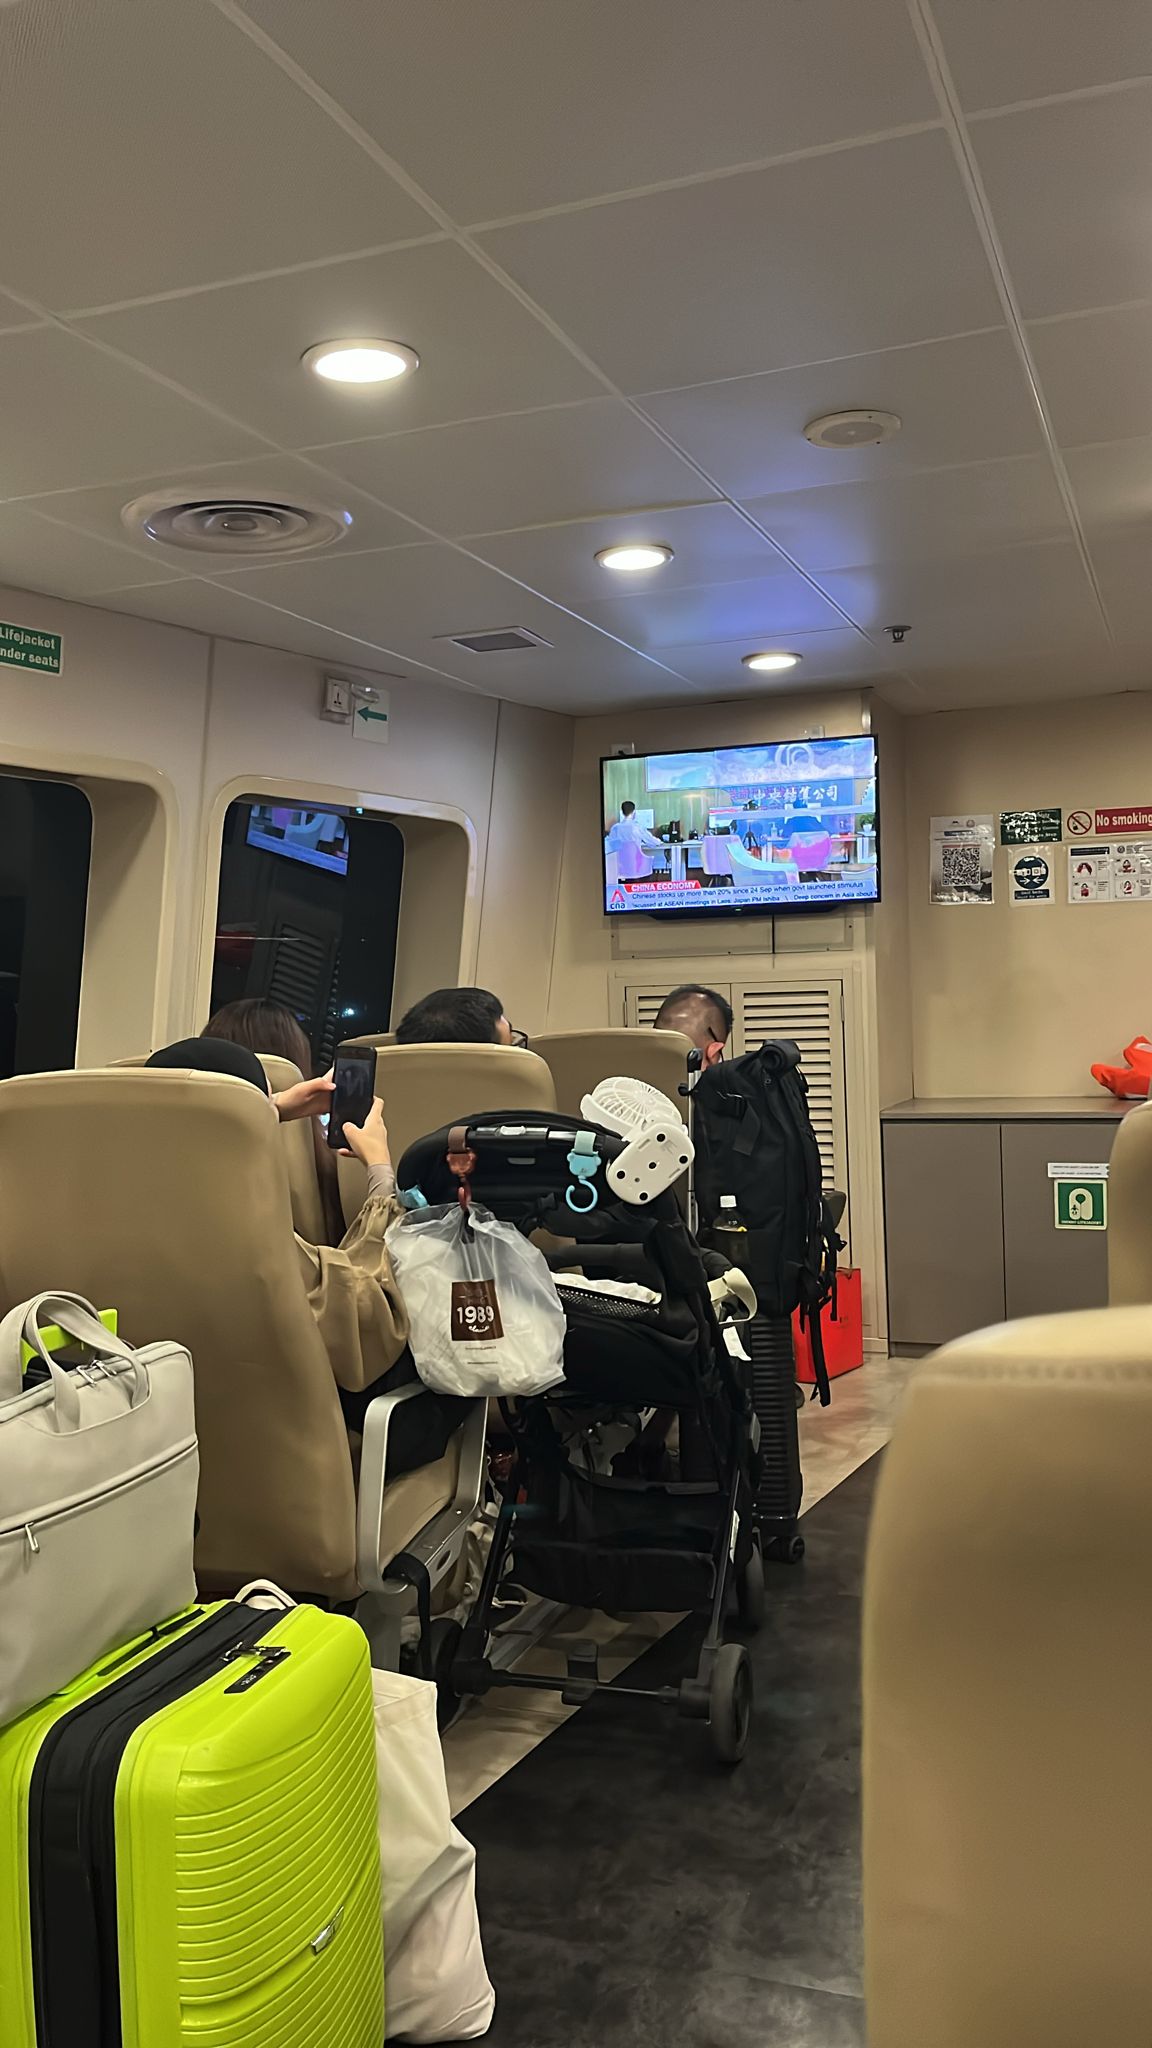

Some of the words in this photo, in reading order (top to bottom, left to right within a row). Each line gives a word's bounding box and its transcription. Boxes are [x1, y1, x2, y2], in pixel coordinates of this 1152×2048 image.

[0, 626, 55, 650] Lifejacket
[0, 647, 26, 661] nder
[29, 654, 59, 668] seats
[1096, 814, 1110, 826] No
[1112, 811, 1152, 826] smoking
[631, 883, 655, 892] CHINA
[657, 881, 696, 891] ECONOMY
[632, 892, 656, 900] Chinese
[658, 891, 676, 899] stocks
[677, 891, 685, 899] up
[703, 888, 716, 896] than
[717, 888, 731, 896] 20%
[760, 886, 772, 894] Sep
[791, 885, 805, 893] govt
[806, 883, 836, 891] launched
[837, 881, 864, 889] stimulus
[632, 901, 657, 909] scussed
[685, 898, 709, 906] meetings
[456, 1305, 495, 1324] 1989
